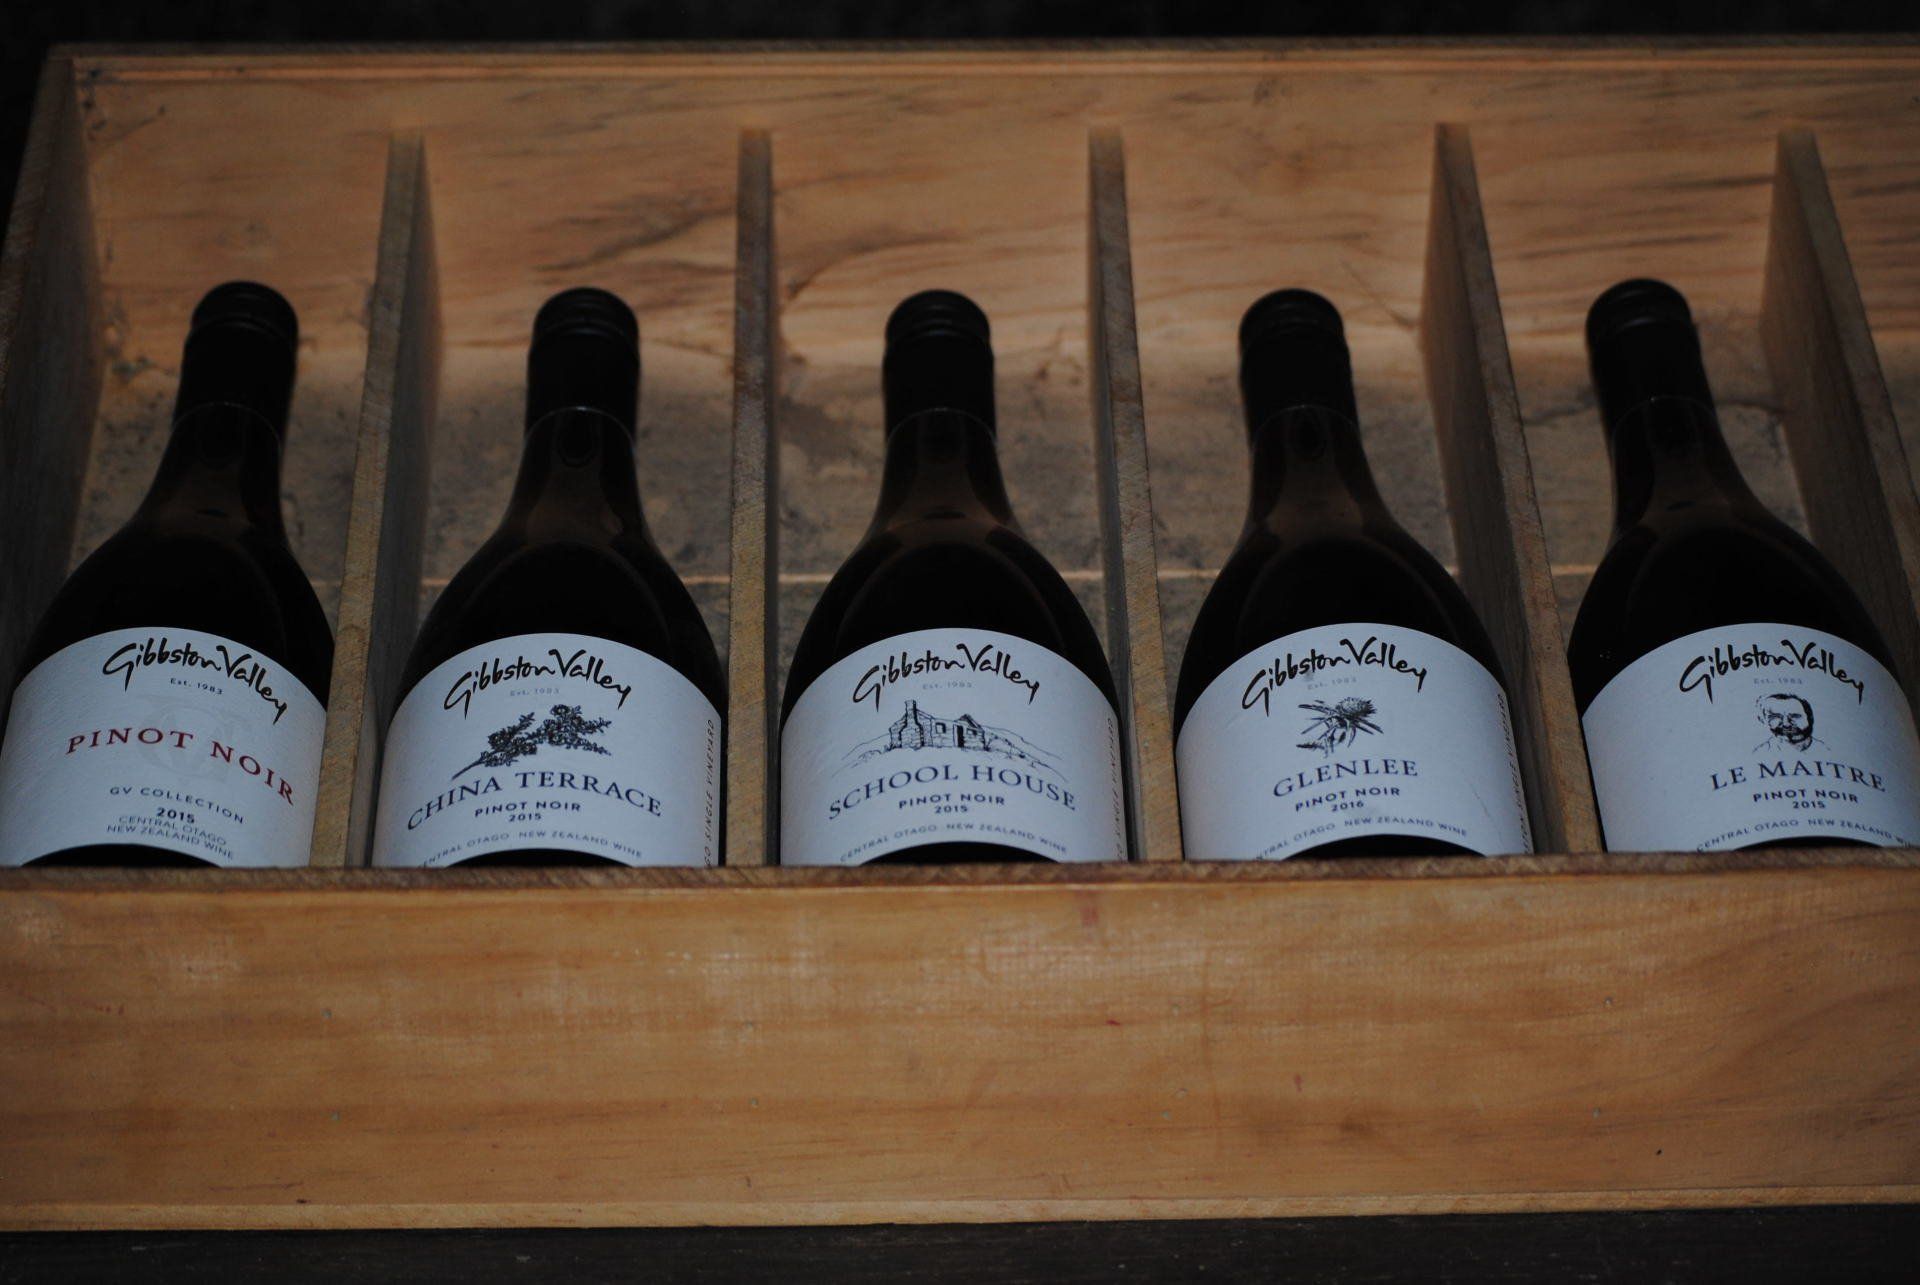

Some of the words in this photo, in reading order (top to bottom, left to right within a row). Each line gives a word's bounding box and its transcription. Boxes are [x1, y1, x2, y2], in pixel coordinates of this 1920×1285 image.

[102, 637, 221, 692] Gibbston
[216, 645, 287, 725] Valley
[170, 677, 192, 688] Est.
[197, 681, 223, 695] 1983
[443, 655, 556, 719] Gibbston
[548, 649, 632, 709] Valley
[852, 650, 965, 712] Gibbston
[956, 643, 1040, 705] Valley
[1241, 648, 1350, 717] Gibbston
[1340, 636, 1427, 692] Valley
[1679, 644, 1791, 704] Gibbston
[1781, 639, 1864, 705] Valley
[65, 727, 194, 756] PINOT
[210, 740, 294, 806] NOIR
[1273, 758, 1418, 798] GLENLEE
[1710, 766, 1747, 791] LE
[1759, 760, 1886, 792] MAITRE
[110, 786, 133, 796] GV
[140, 787, 244, 825] COLLECTION
[408, 776, 502, 831] CHINA
[515, 771, 662, 817] TERRACE
[474, 801, 528, 818] PINOT
[535, 800, 581, 812] NOIR
[828, 764, 959, 821] SCHOOL
[970, 764, 1077, 811] HOUSE
[899, 793, 951, 810] PINOT
[960, 793, 1005, 806] NOIR
[934, 804, 969, 814] 2015
[1295, 790, 1346, 812] PINOT
[1356, 786, 1401, 797] NOIR
[1331, 800, 1364, 812] 2016
[1753, 788, 1806, 803] PINOT
[1815, 789, 1859, 803] NOIR
[1792, 800, 1826, 810] 2015
[118, 815, 178, 831] CENTRAL
[183, 824, 227, 846] OTAGO
[156, 807, 195, 824] 2015
[508, 812, 542, 822] 2015
[1293, 822, 1337, 842] OTAGO
[1344, 816, 1372, 827] NEW
[1377, 815, 1434, 828] ZEALAND
[1438, 822, 1468, 837] WINE
[106, 825, 136, 833] NEW
[140, 826, 200, 845] ZEALAND
[204, 841, 235, 860] WINE
[418, 845, 462, 868] ENTRAL
[467, 832, 511, 848] OTAGO
[519, 830, 546, 838] NEW
[552, 830, 609, 846] ZEALAND
[613, 842, 643, 859] WINE
[839, 836, 889, 863] CENTRAL
[894, 824, 937, 839] OTAGO
[946, 822, 974, 831] NEW
[979, 823, 1035, 840] ZEALAND
[1039, 837, 1068, 853] WINE
[1696, 826, 1750, 852] CENTRAL
[1754, 818, 1799, 832] OTAGO
[1808, 818, 1836, 827] NEW
[1840, 818, 1892, 840] ZEALAND
